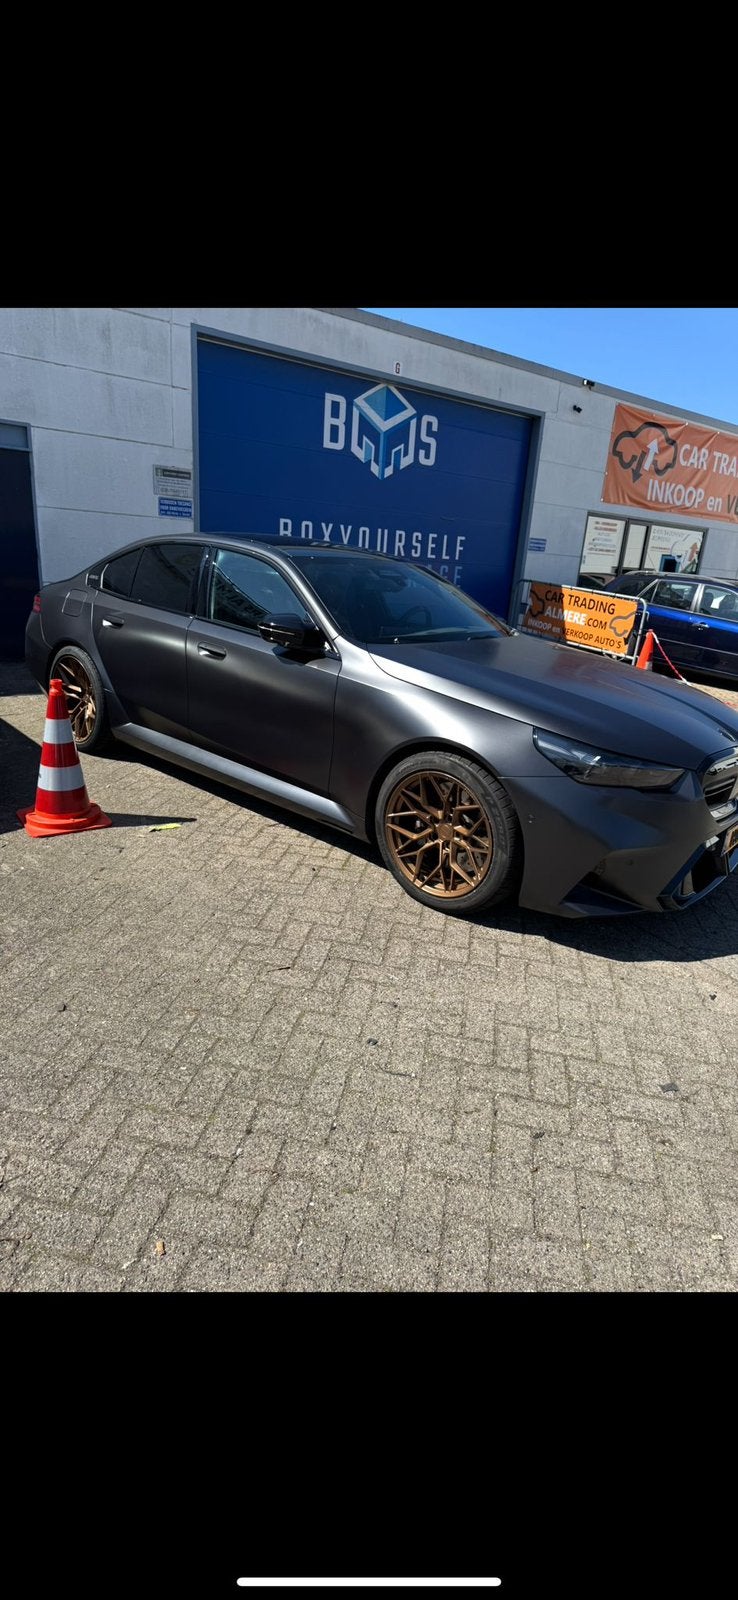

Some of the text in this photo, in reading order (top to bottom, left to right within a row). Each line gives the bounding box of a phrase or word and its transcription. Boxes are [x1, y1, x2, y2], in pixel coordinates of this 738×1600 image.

[395, 362, 400, 374] G
[680, 443, 738, 478] CAR TRA
[647, 479, 705, 508] INKOOP
[706, 495, 722, 512] en
[279, 517, 466, 561] BOXYOURSELF
[545, 589, 616, 615] CAR TRADING
[544, 606, 607, 631] ALMERE.COM
[594, 636, 622, 649] AUTO'S
